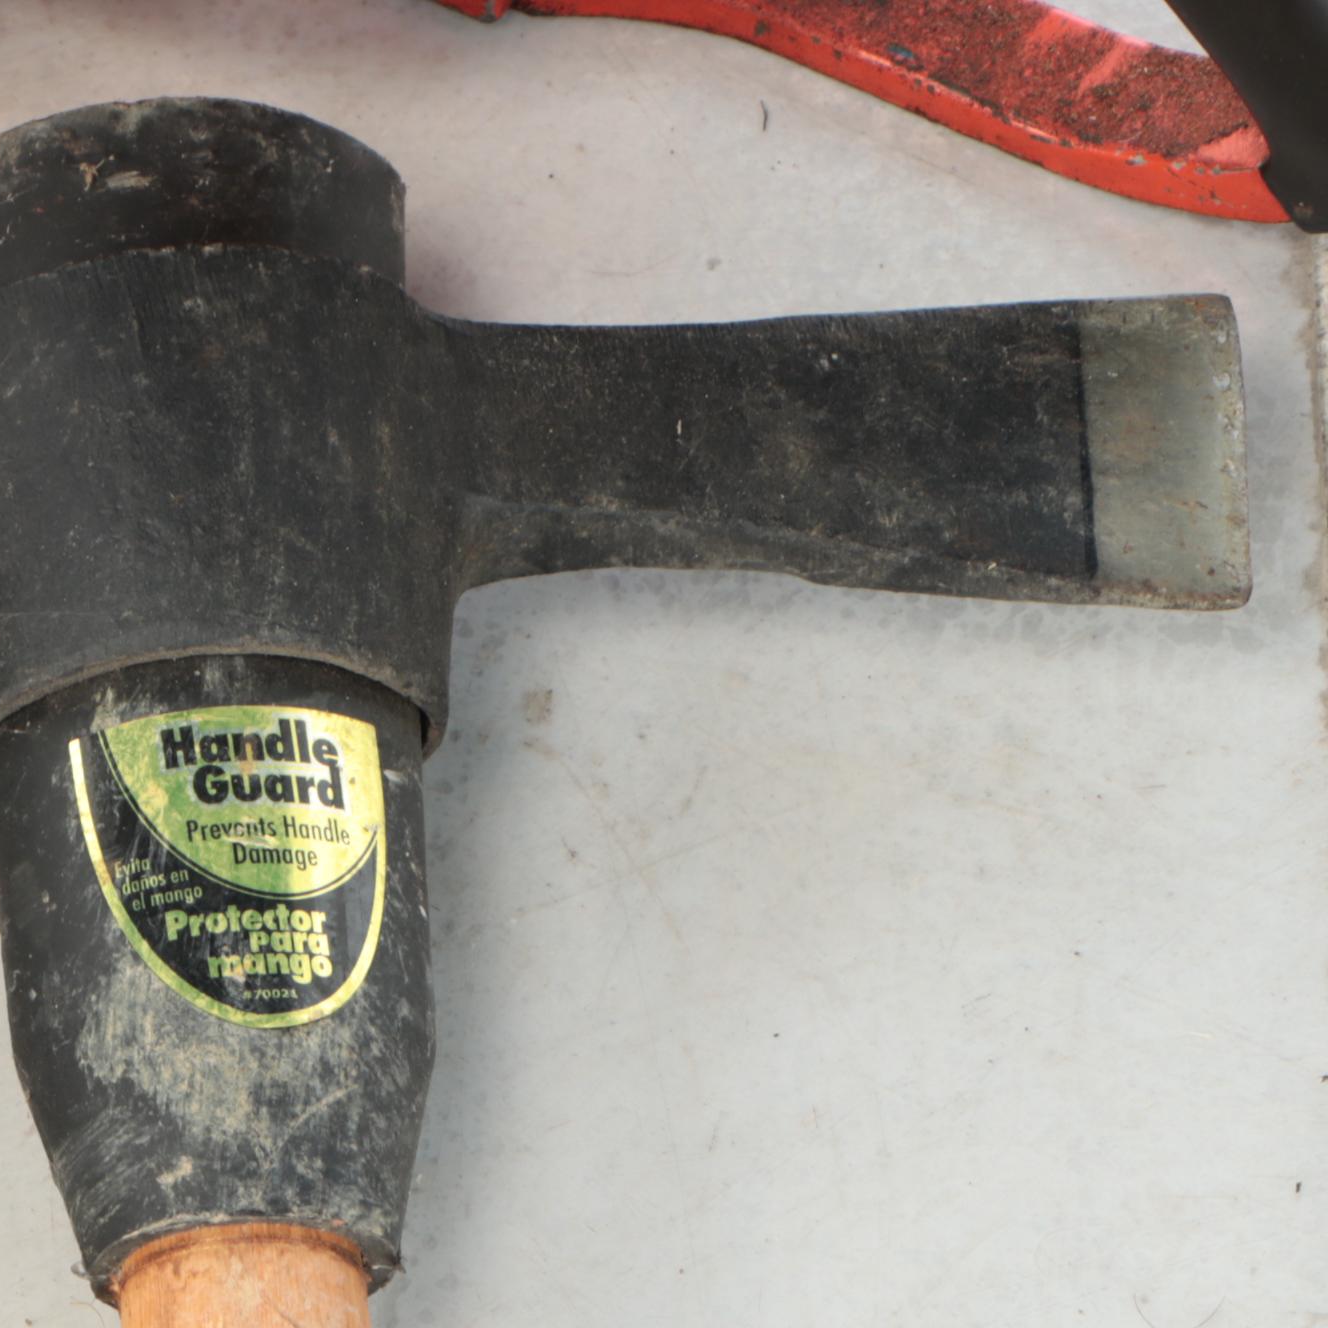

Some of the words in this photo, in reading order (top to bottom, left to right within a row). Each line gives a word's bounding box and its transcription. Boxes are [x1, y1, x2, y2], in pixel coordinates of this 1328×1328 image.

[160, 718, 340, 770] Handle
[192, 762, 345, 811] Guard
[186, 817, 277, 843] Prevents
[283, 815, 351, 846] Handle
[114, 857, 151, 880] Evita
[233, 843, 318, 871] Damage
[171, 868, 190, 885] en
[132, 894, 145, 913] el
[150, 886, 203, 908] mango
[164, 903, 327, 942] Protector
[249, 930, 331, 957] para
[206, 951, 334, 985] mango
